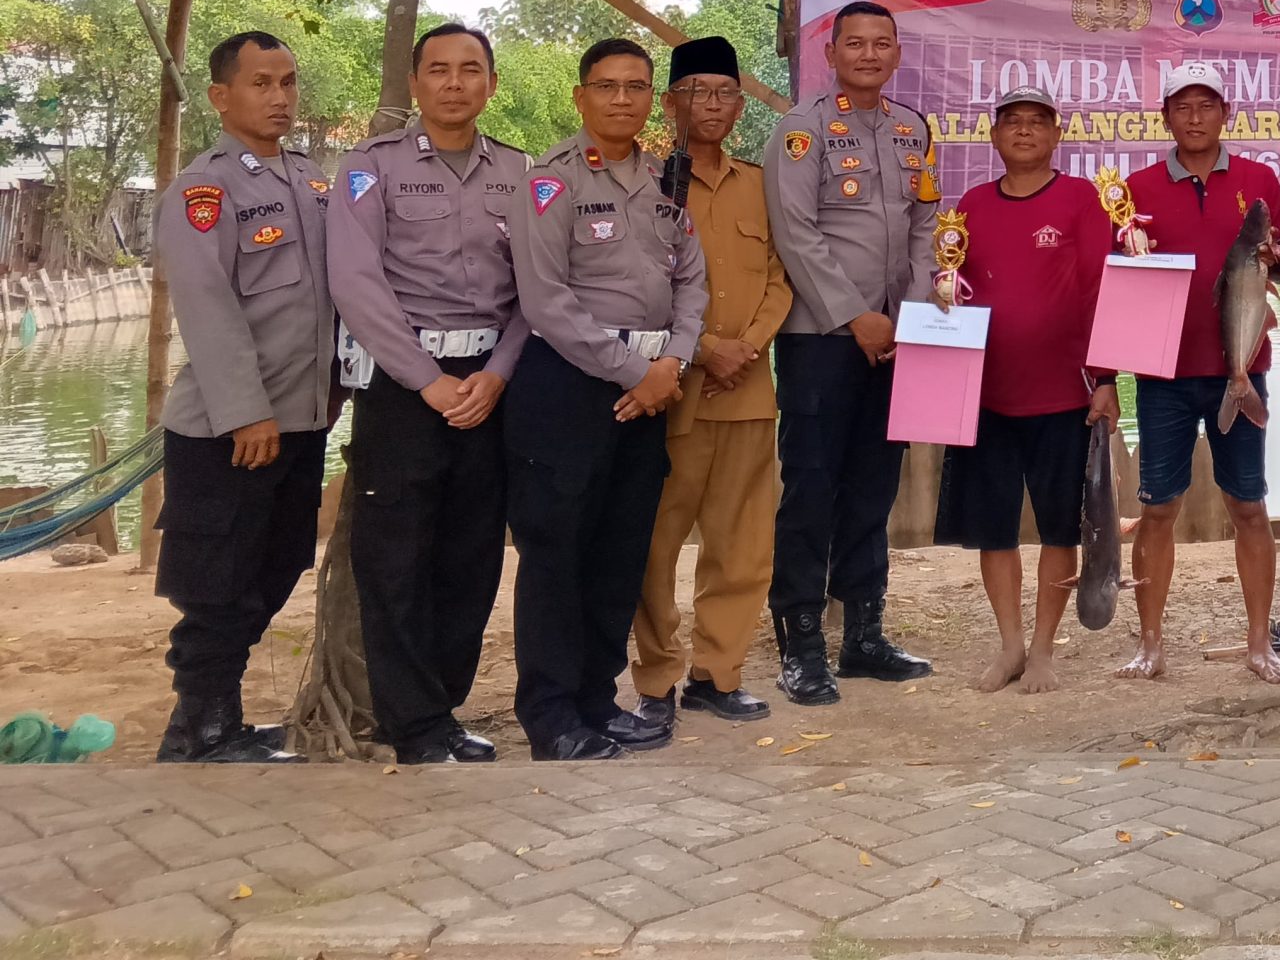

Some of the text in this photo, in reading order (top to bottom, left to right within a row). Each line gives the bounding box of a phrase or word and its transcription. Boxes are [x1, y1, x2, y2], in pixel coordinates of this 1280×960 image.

[968, 59, 1142, 104] LOMBA
[828, 137, 861, 149] RONI
[892, 137, 923, 149] POLRI
[400, 183, 445, 194] RIYONO
[1039, 233, 1056, 243] DJ
